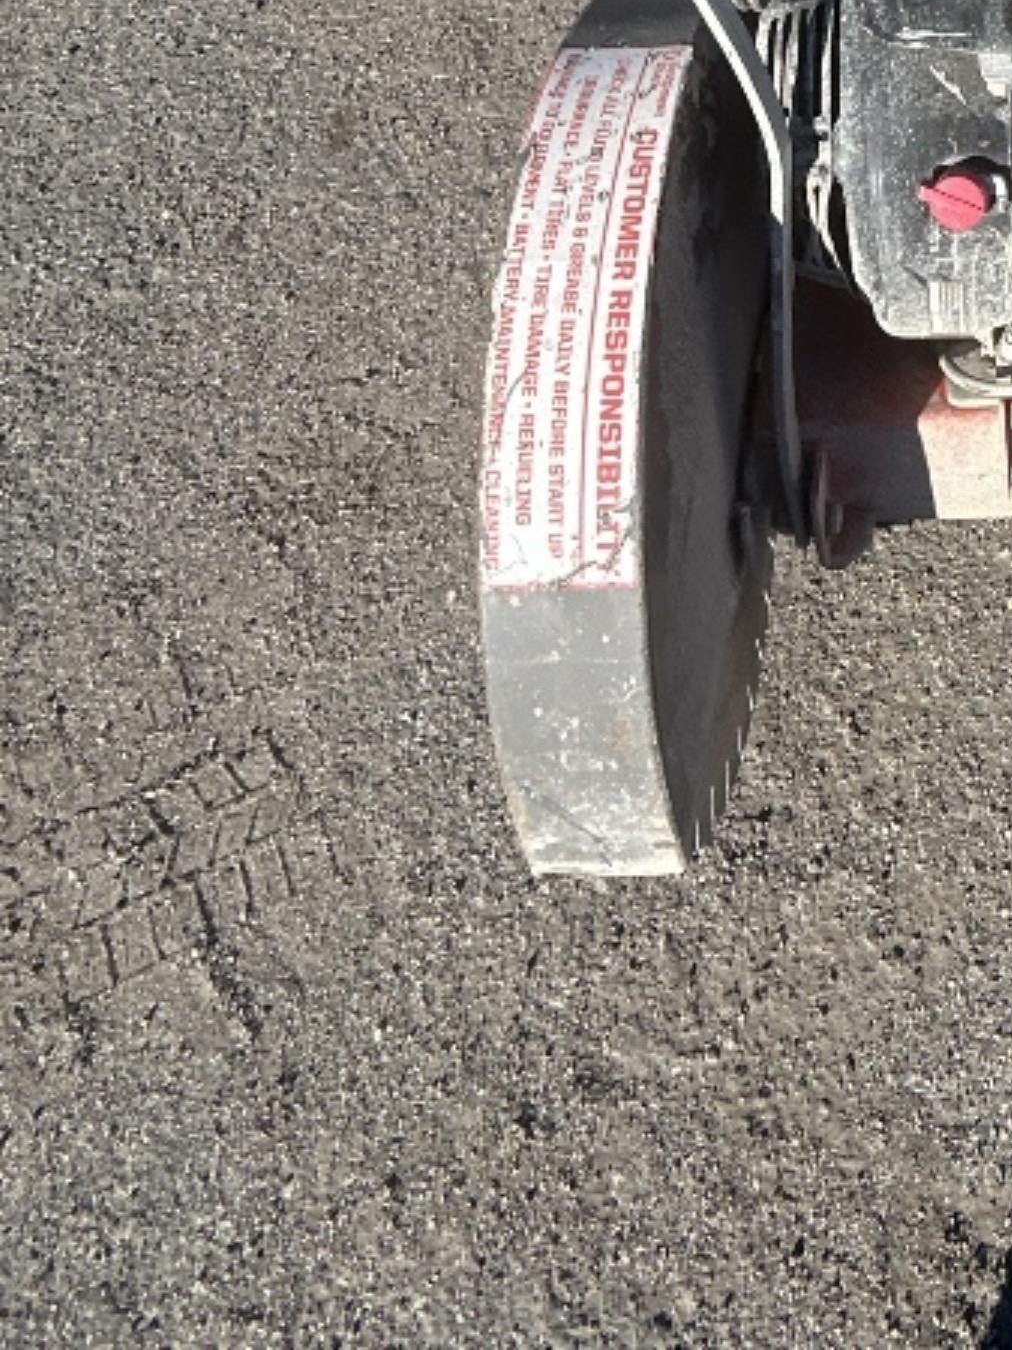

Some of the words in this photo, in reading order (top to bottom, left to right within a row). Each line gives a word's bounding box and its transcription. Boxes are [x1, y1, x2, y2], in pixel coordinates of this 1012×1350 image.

[552, 161, 574, 195] FLAT
[577, 165, 600, 222] LEVELS
[612, 129, 660, 281] CUSTOMER
[503, 223, 530, 300] BATTERY
[532, 264, 553, 307] TIRE
[561, 242, 585, 314] GREASE
[522, 314, 547, 397] DAMAGE
[554, 320, 576, 375] DAILY
[549, 380, 571, 457] BEFORE
[548, 464, 565, 527] START
[548, 533, 564, 559] UP
